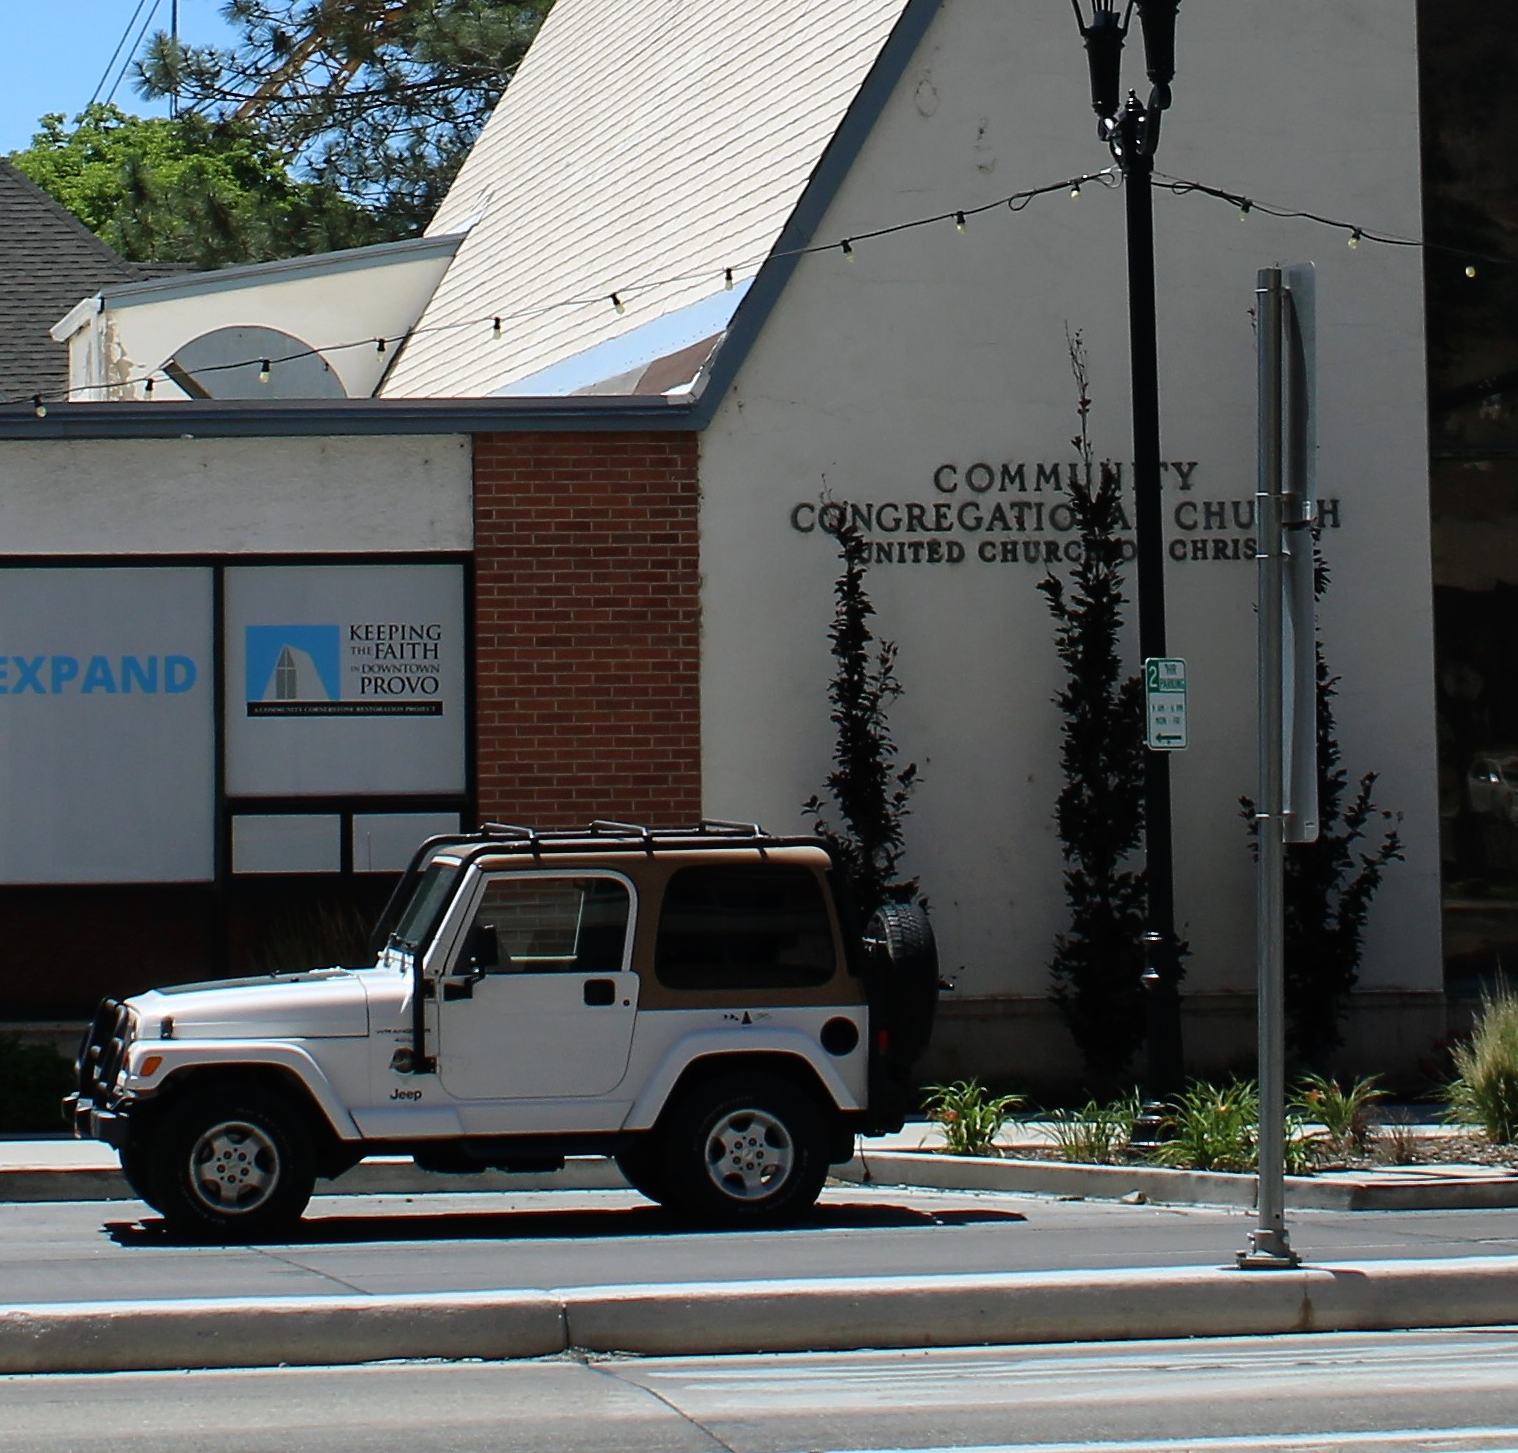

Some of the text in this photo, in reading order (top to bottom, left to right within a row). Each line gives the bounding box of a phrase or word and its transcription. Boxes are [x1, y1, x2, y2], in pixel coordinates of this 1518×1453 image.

[1174, 498, 1341, 531] CHUH
[1169, 538, 1257, 561] CHRIS
[350, 624, 441, 641] KEEPING
[351, 642, 439, 660] THE FAITH
[362, 663, 440, 673] DOWNTOWN
[1149, 666, 1158, 687] 2
[361, 676, 439, 694] PROVO
[390, 1088, 422, 1101] Jeep
